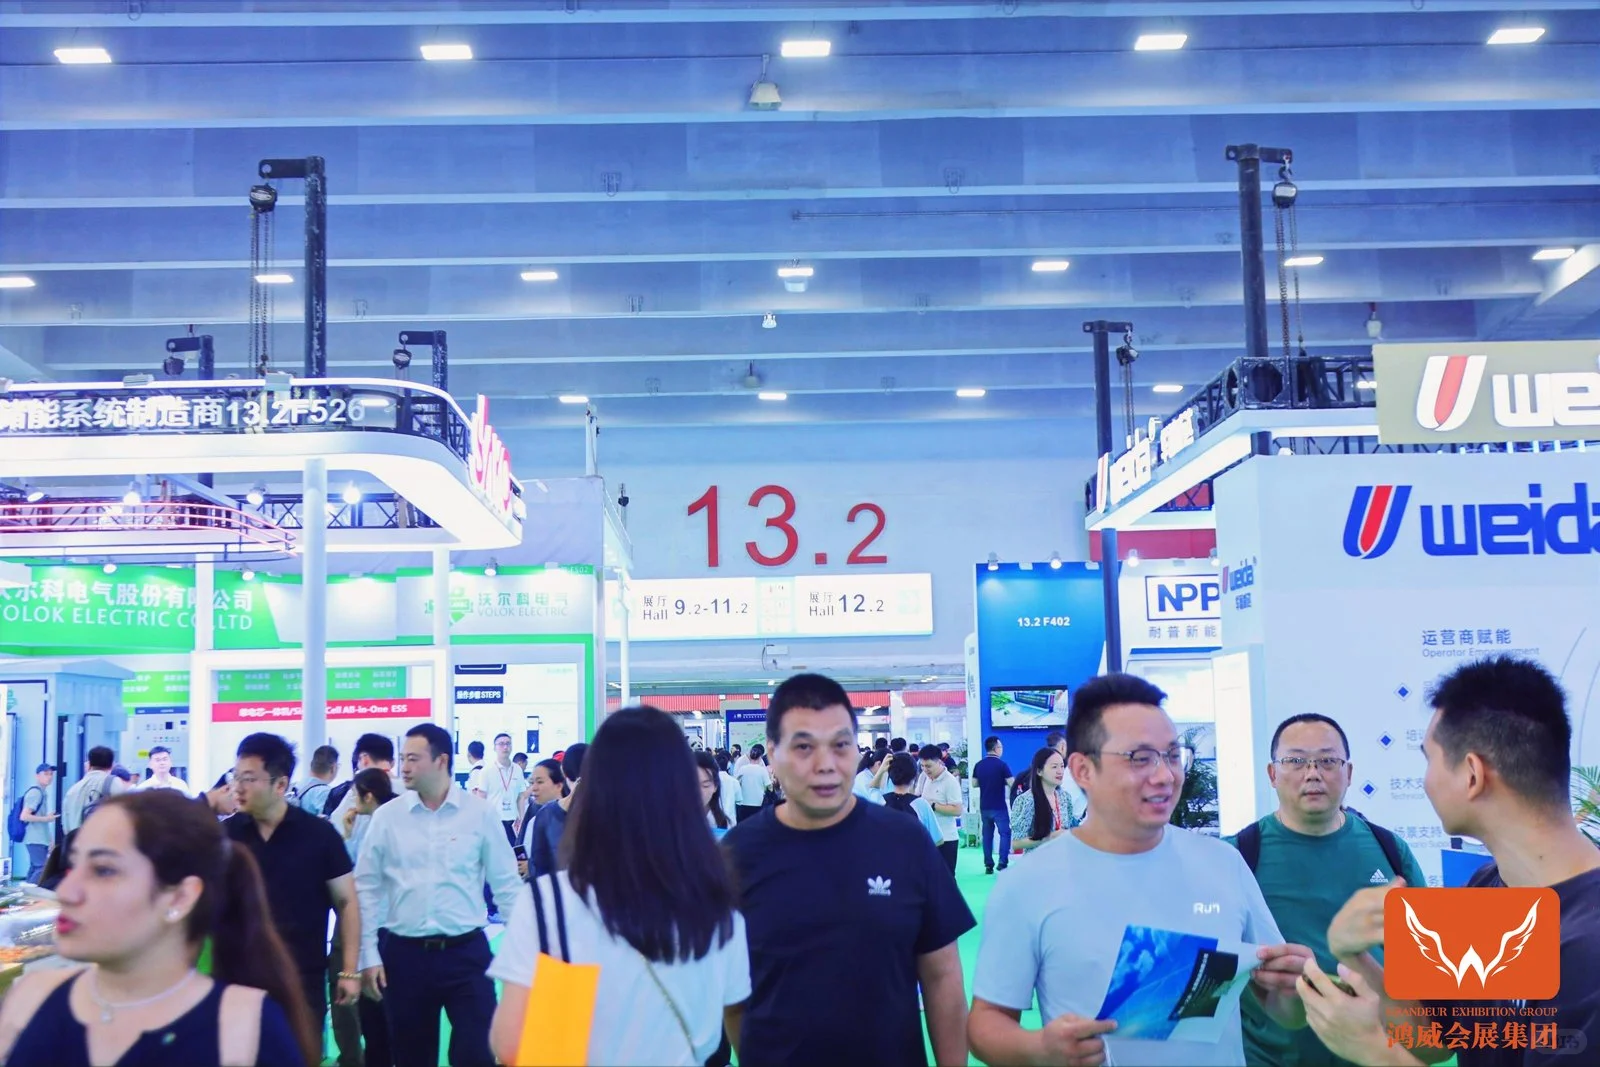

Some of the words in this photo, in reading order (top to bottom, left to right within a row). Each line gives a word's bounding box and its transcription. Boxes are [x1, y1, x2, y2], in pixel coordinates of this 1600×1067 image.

[686, 484, 888, 568] 13.2
[1420, 482, 1600, 557] weid
[643, 595, 668, 608] 展厅
[643, 609, 668, 621] Hall
[674, 597, 749, 616] 9.2-11.2
[808, 605, 835, 617] Hall
[838, 594, 885, 613] 12.2
[0, 603, 65, 624] OLOK
[72, 607, 171, 627] ELECTRIC
[478, 606, 514, 618] VOLOK
[518, 606, 568, 618] ELECTRIC
[1017, 617, 1041, 627] 13.2
[1043, 616, 1071, 627] F402
[1422, 628, 1512, 646] 运营商赋能
[1422, 646, 1466, 659] Operator
[391, 703, 407, 713] ESS
